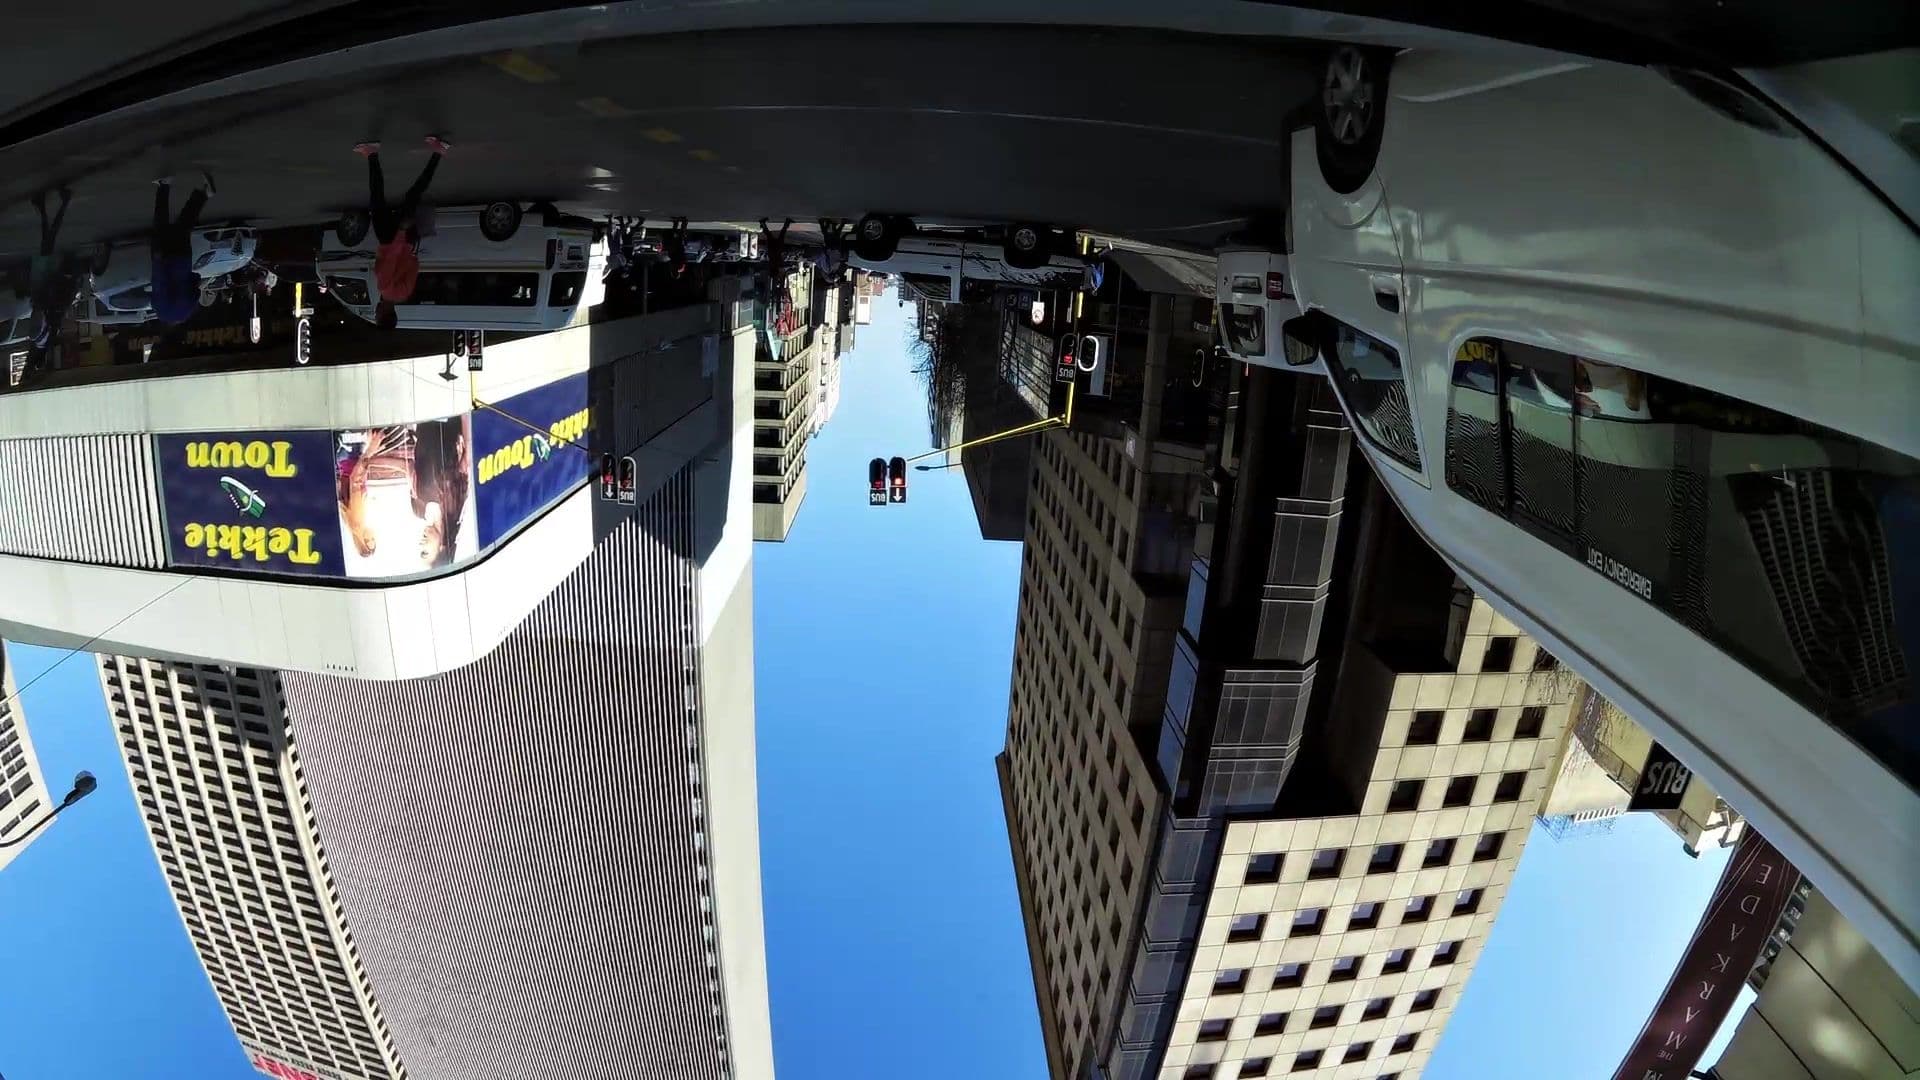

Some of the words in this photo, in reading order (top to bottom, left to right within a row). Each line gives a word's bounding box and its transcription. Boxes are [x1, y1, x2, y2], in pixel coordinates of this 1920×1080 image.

[469, 358, 482, 368] BUS
[1059, 368, 1073, 378] BUS
[185, 440, 297, 478] Town
[478, 434, 534, 485] Town
[620, 491, 634, 501] BUS
[871, 492, 886, 503] BUS
[184, 523, 321, 565] Tekkie
[1586, 545, 1603, 572] EXIT
[1603, 555, 1652, 600] EMERGENCY
[1641, 761, 1689, 794] BUS
[1664, 863, 1773, 1050] MARKADE
[1656, 1049, 1674, 1061] THE
